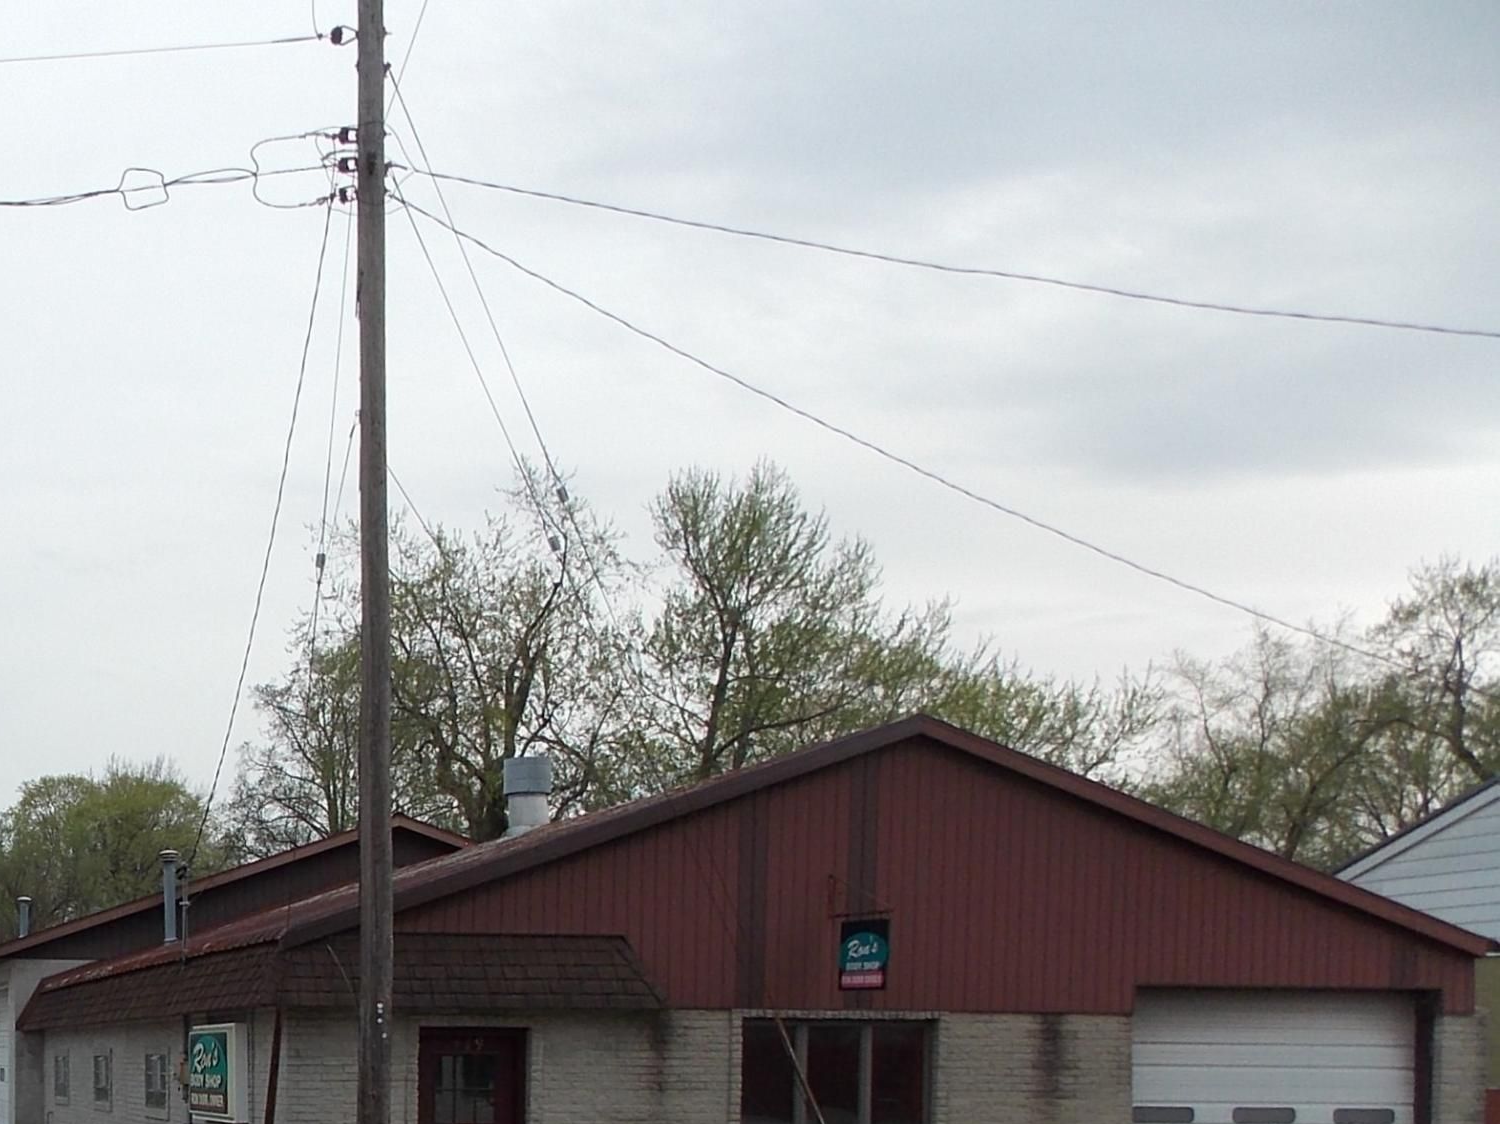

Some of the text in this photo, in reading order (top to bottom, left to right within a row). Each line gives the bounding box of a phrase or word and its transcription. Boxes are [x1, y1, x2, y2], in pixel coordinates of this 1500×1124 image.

[847, 935, 879, 959] Ron's
[192, 1041, 219, 1073] Ron's
[205, 1074, 221, 1088] SHOP
